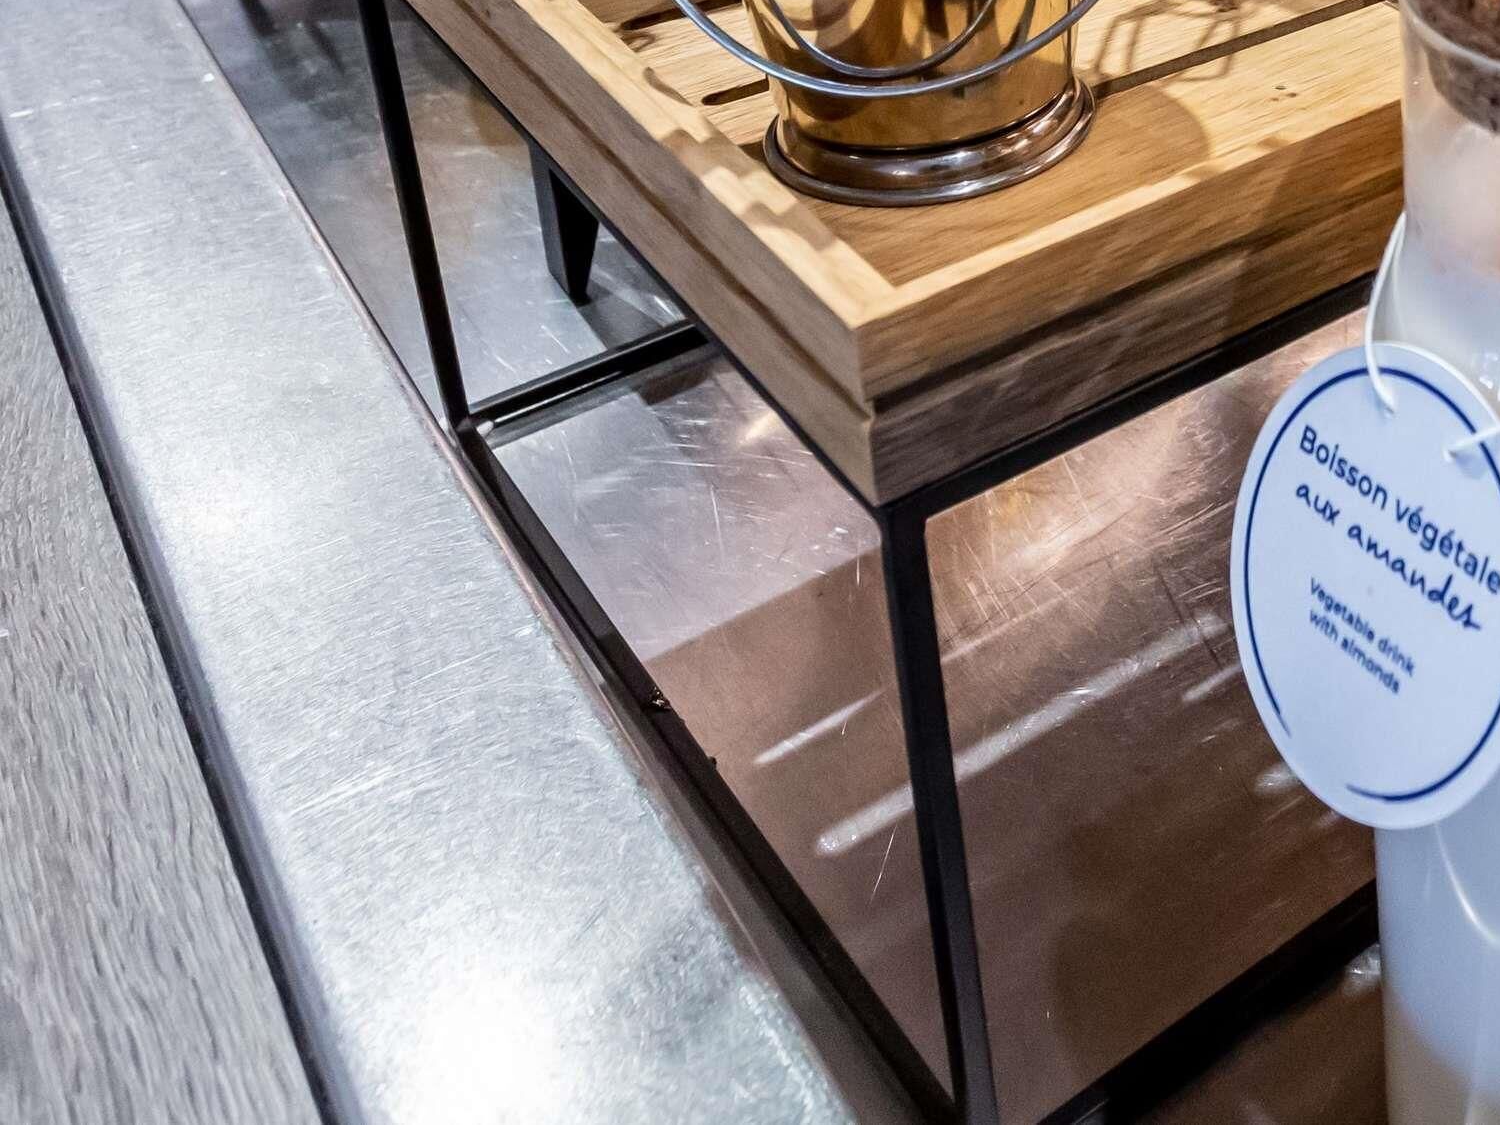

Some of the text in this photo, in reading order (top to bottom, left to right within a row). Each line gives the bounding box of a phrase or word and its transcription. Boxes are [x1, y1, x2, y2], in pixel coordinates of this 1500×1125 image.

[1299, 425, 1389, 507] Boisson
[1295, 482, 1481, 630] aux amandes
[1309, 610, 1400, 694] with almonds
[1310, 577, 1415, 677] Vegetable drink
